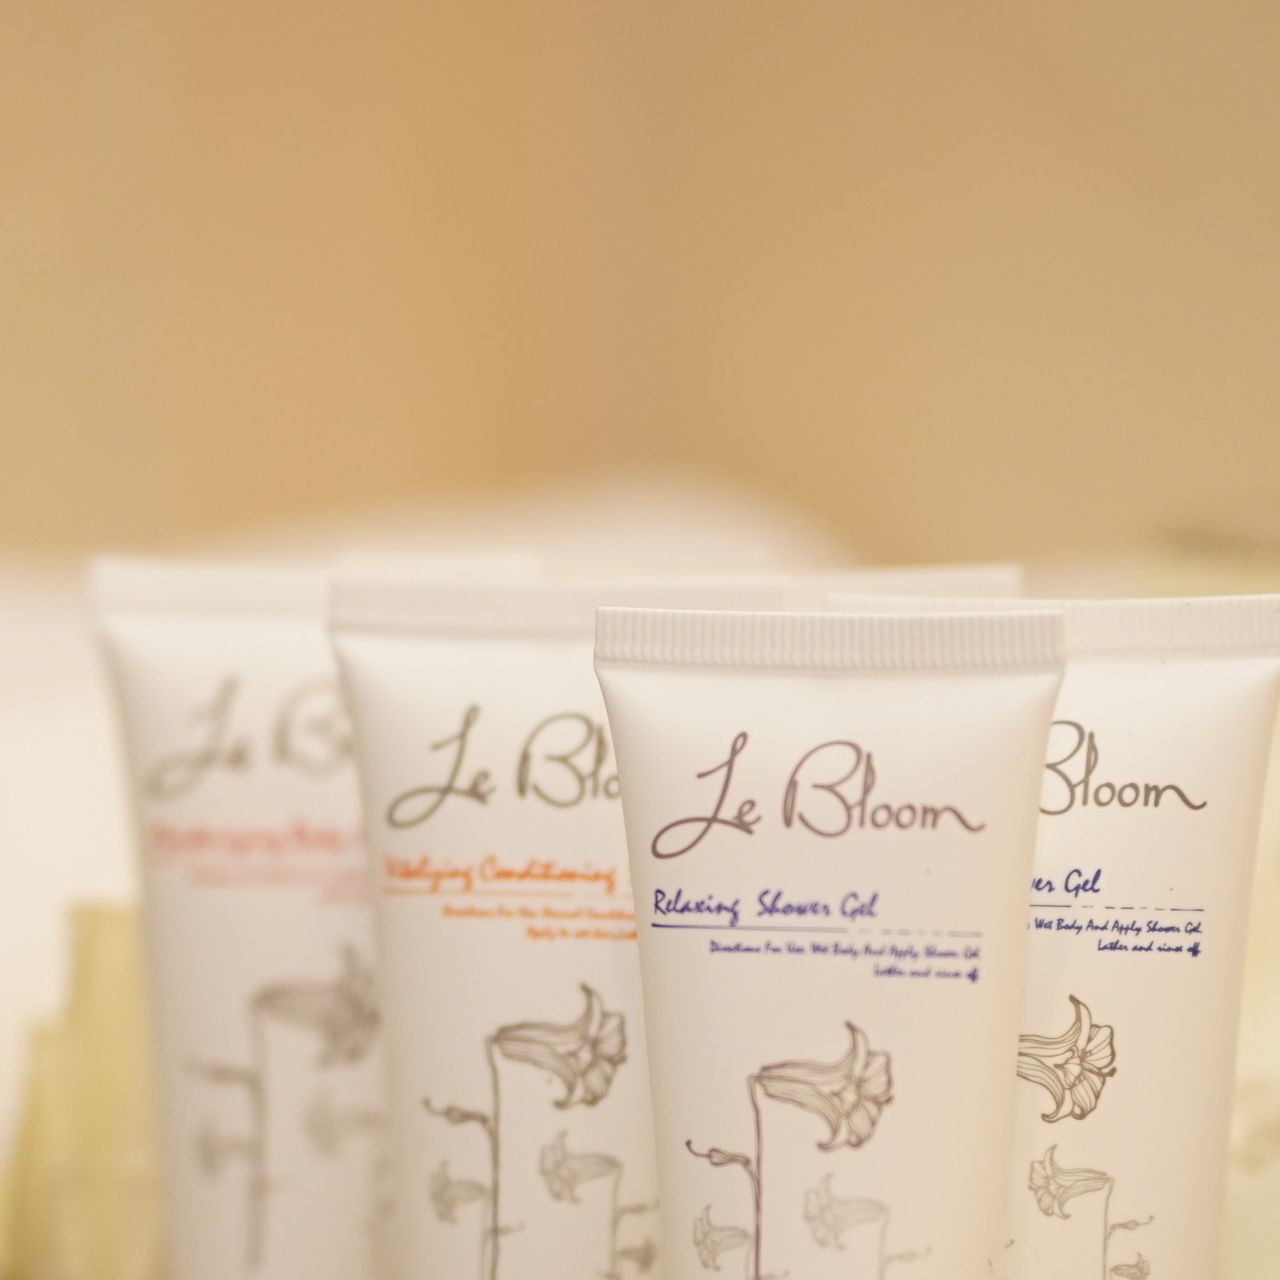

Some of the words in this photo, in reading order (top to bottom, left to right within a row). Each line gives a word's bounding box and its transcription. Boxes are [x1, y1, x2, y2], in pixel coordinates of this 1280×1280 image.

[386, 704, 498, 829] Le
[518, 712, 621, 808] Blo
[651, 731, 761, 859] Le
[782, 740, 986, 838] Bloom
[479, 855, 616, 893] Conditioning
[1064, 869, 1102, 897] Gel
[654, 889, 740, 927] Relaxing
[757, 889, 831, 917] Shower
[840, 892, 879, 921] Gel
[1056, 918, 1083, 935] Body
[1086, 919, 1109, 931] And
[1111, 920, 1142, 935] Apply
[1146, 921, 1180, 933] Shower
[1184, 922, 1202, 934] Gel
[1097, 939, 1129, 951] Lather
[1131, 941, 1153, 951] and
[1157, 942, 1184, 952] rinse
